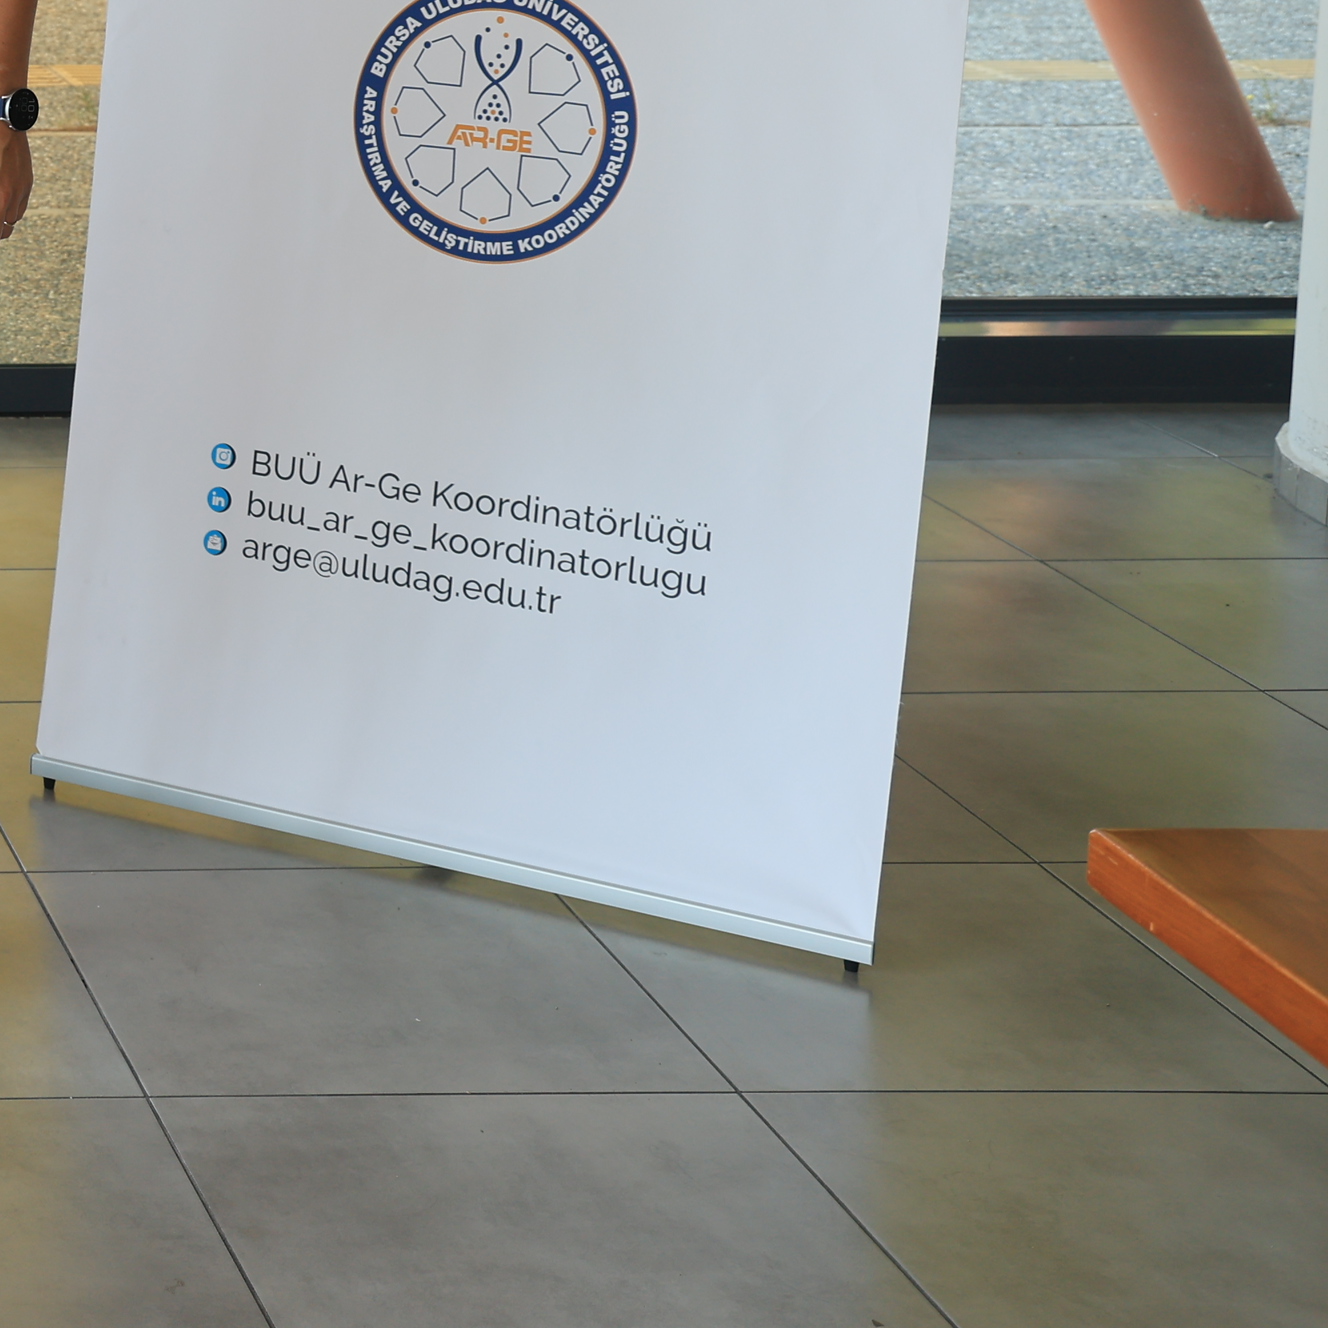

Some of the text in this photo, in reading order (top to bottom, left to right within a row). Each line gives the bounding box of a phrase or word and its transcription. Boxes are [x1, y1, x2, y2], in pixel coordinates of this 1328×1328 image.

[370, 16, 422, 78] BURSA
[358, 86, 629, 255] ARAŞTIRMA VE GELİŞTİRME KOORDİNATÖRLÜĞÜ
[446, 124, 532, 153] AR-GE
[246, 490, 707, 599] buu_ar_ge_koordinatorlugu
[251, 450, 712, 554] BUÜ Ar-Ge Koordinatörlüğü
[241, 534, 562, 614] arge@uludag.edu.tr
